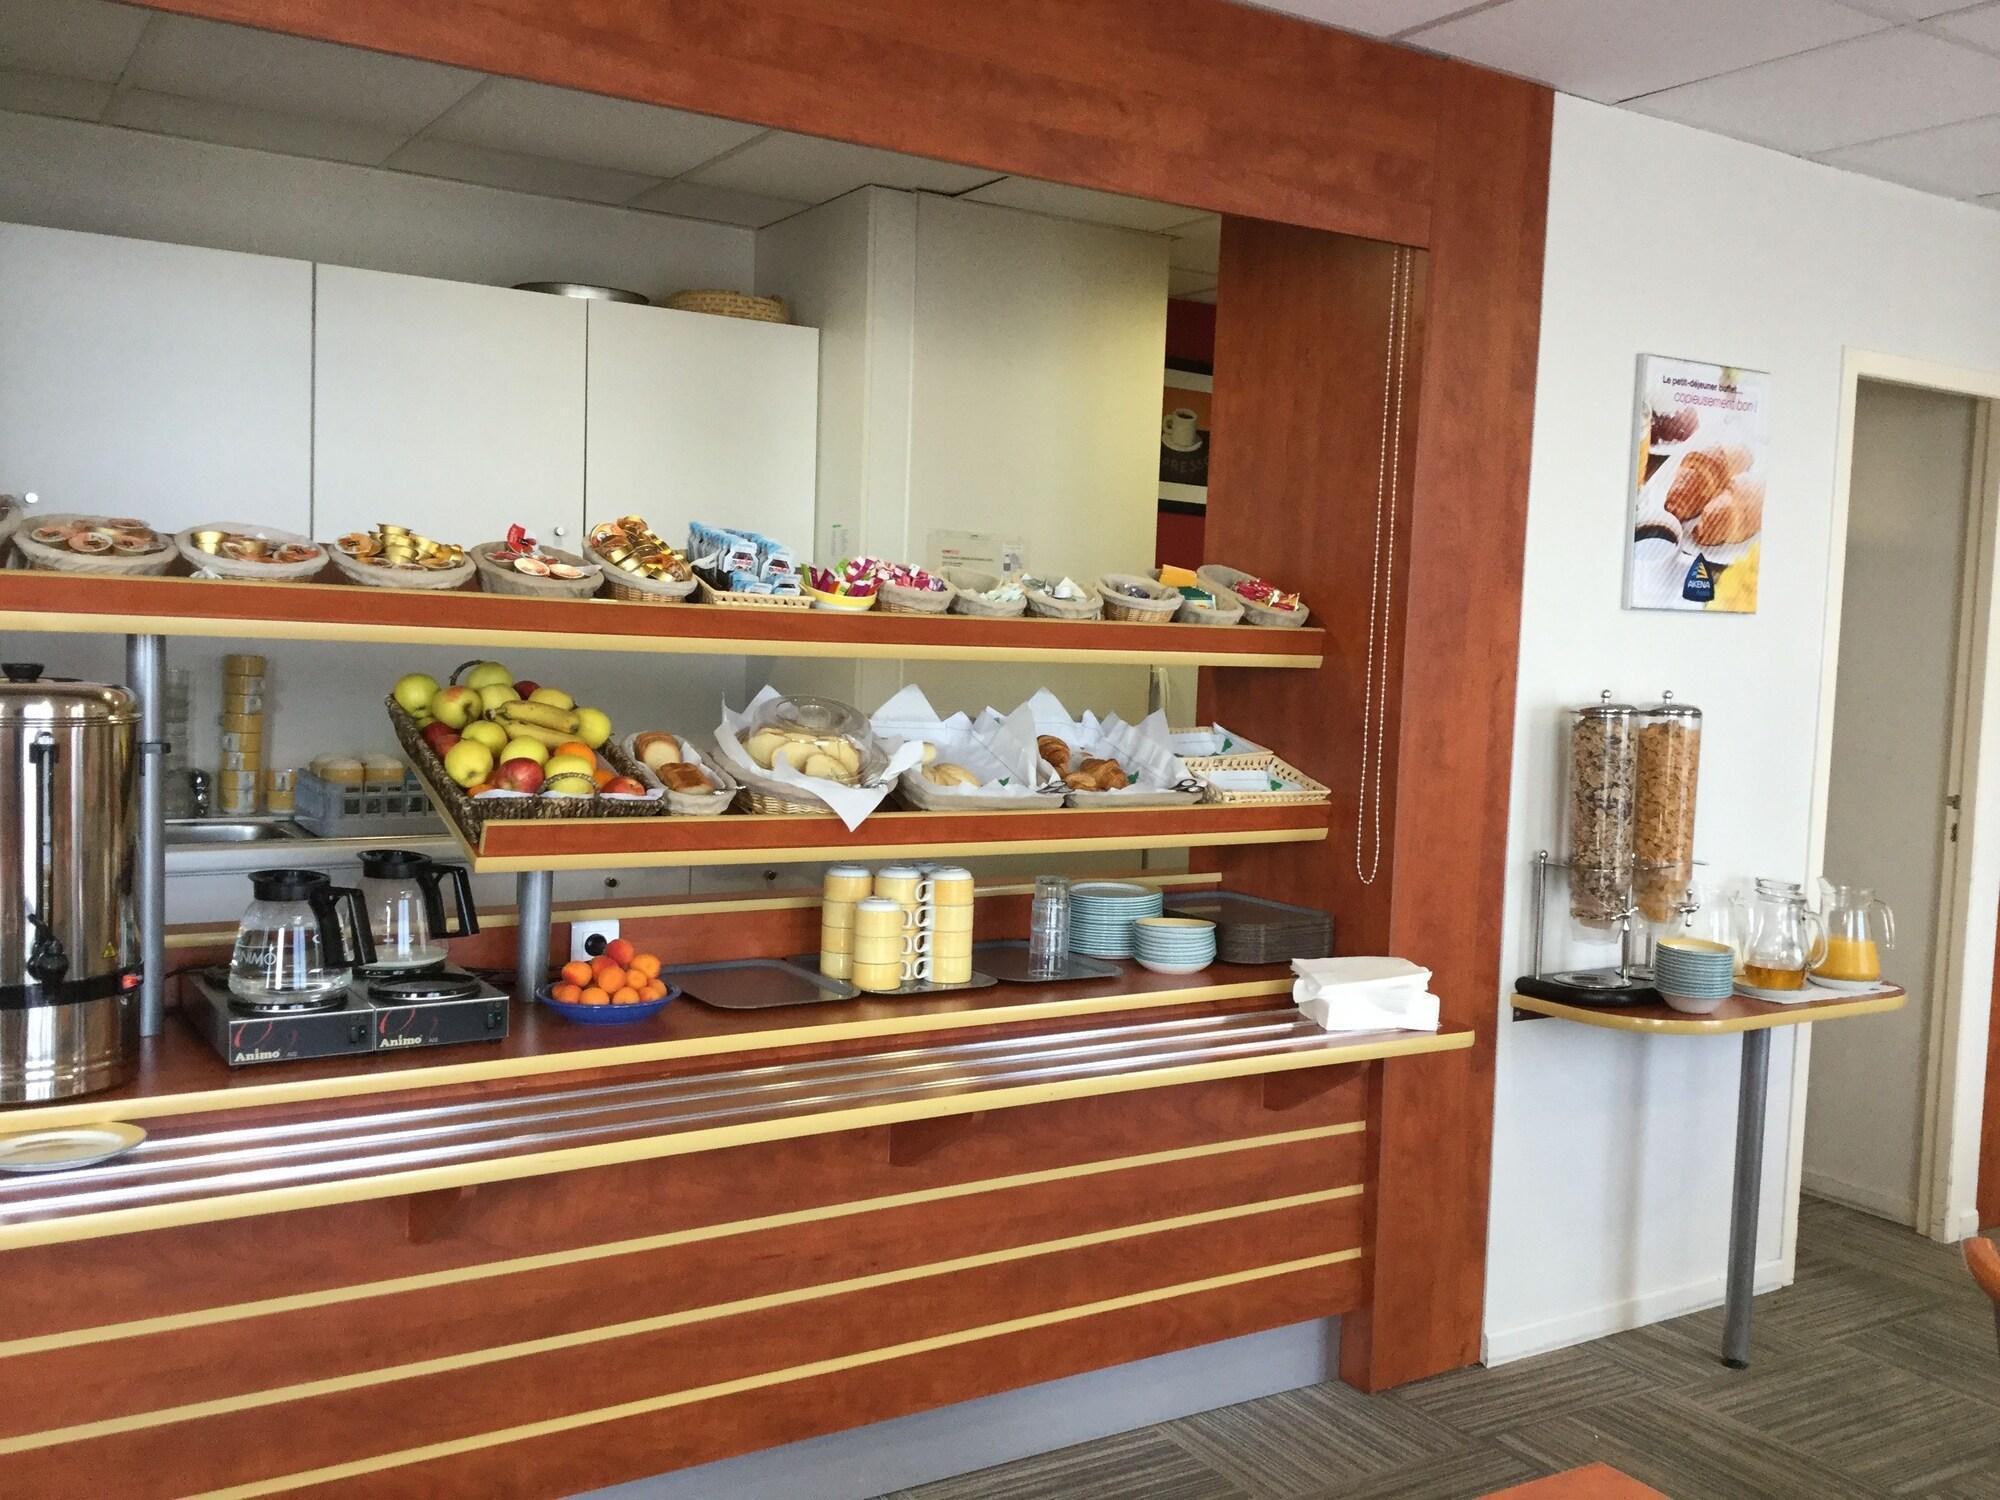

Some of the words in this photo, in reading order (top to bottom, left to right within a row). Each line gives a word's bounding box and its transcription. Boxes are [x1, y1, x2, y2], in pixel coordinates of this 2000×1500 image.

[1662, 375, 1671, 384] Le
[1674, 392, 1735, 409] copieusement
[1687, 580, 1710, 588] AKENA
[379, 1035, 422, 1048] Animo
[234, 1048, 281, 1063] Animo
